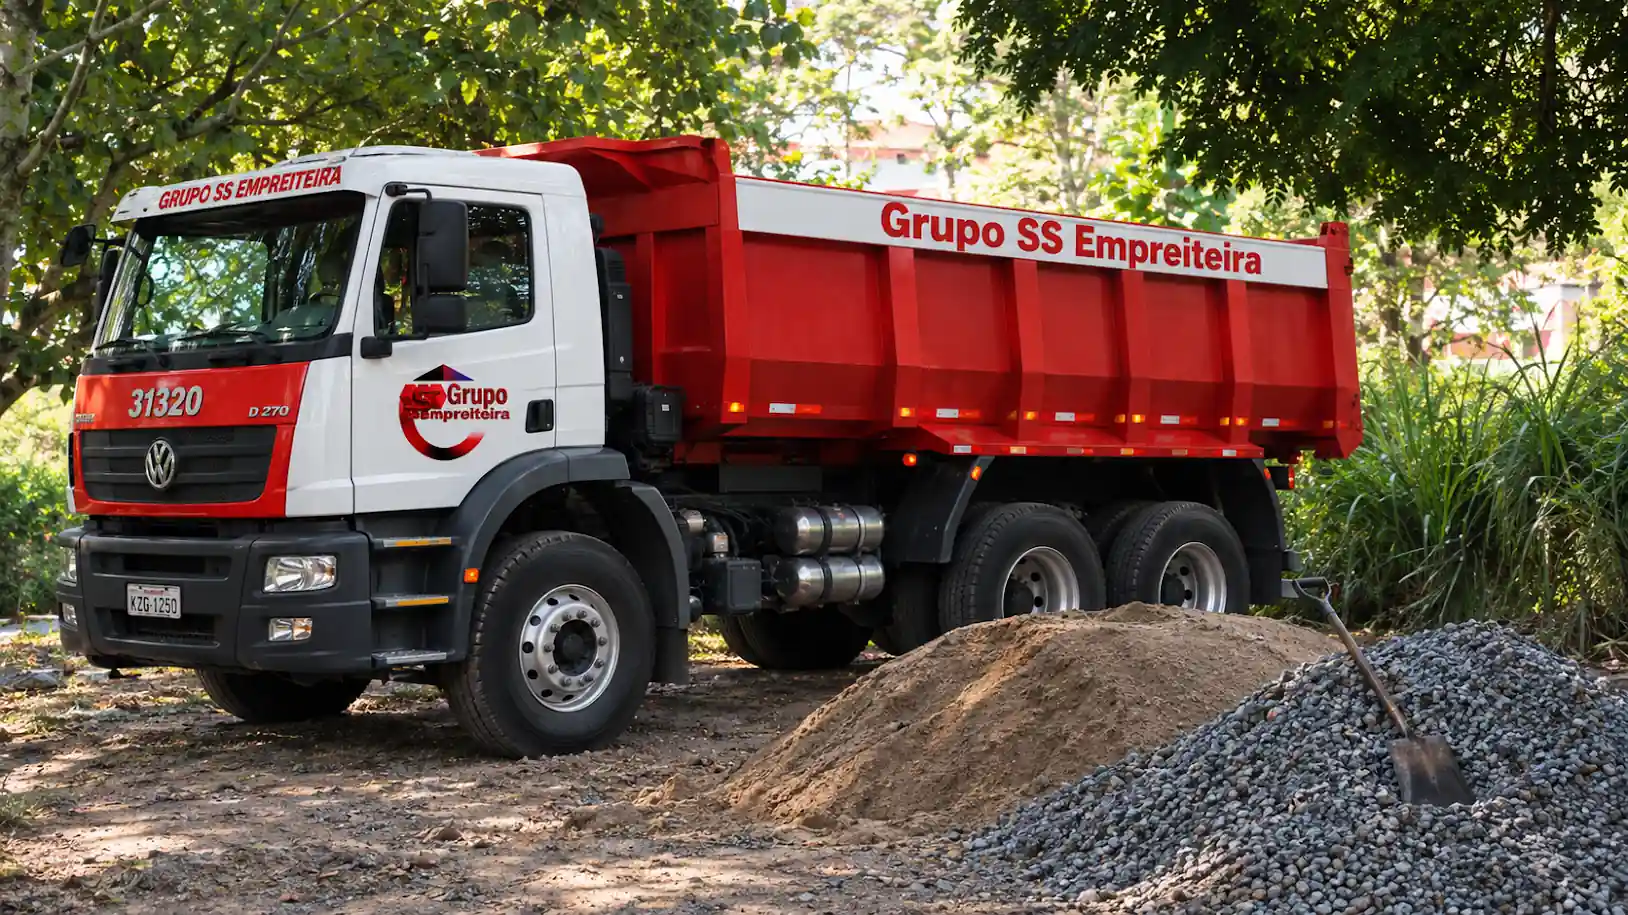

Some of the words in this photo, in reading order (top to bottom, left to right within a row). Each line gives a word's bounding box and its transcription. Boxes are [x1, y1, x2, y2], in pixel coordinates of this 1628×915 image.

[158, 184, 212, 210] GRUPO
[213, 181, 234, 202] SS
[235, 165, 342, 199] EMPREITEIRA
[881, 201, 1005, 252] Grupo
[1017, 217, 1063, 255] SS
[1075, 224, 1262, 275] Empreiteira
[128, 385, 204, 418] 31320
[447, 383, 508, 409] Grupo
[248, 406, 259, 417] D
[261, 405, 290, 417] 270
[130, 595, 178, 614] KZG-1250
